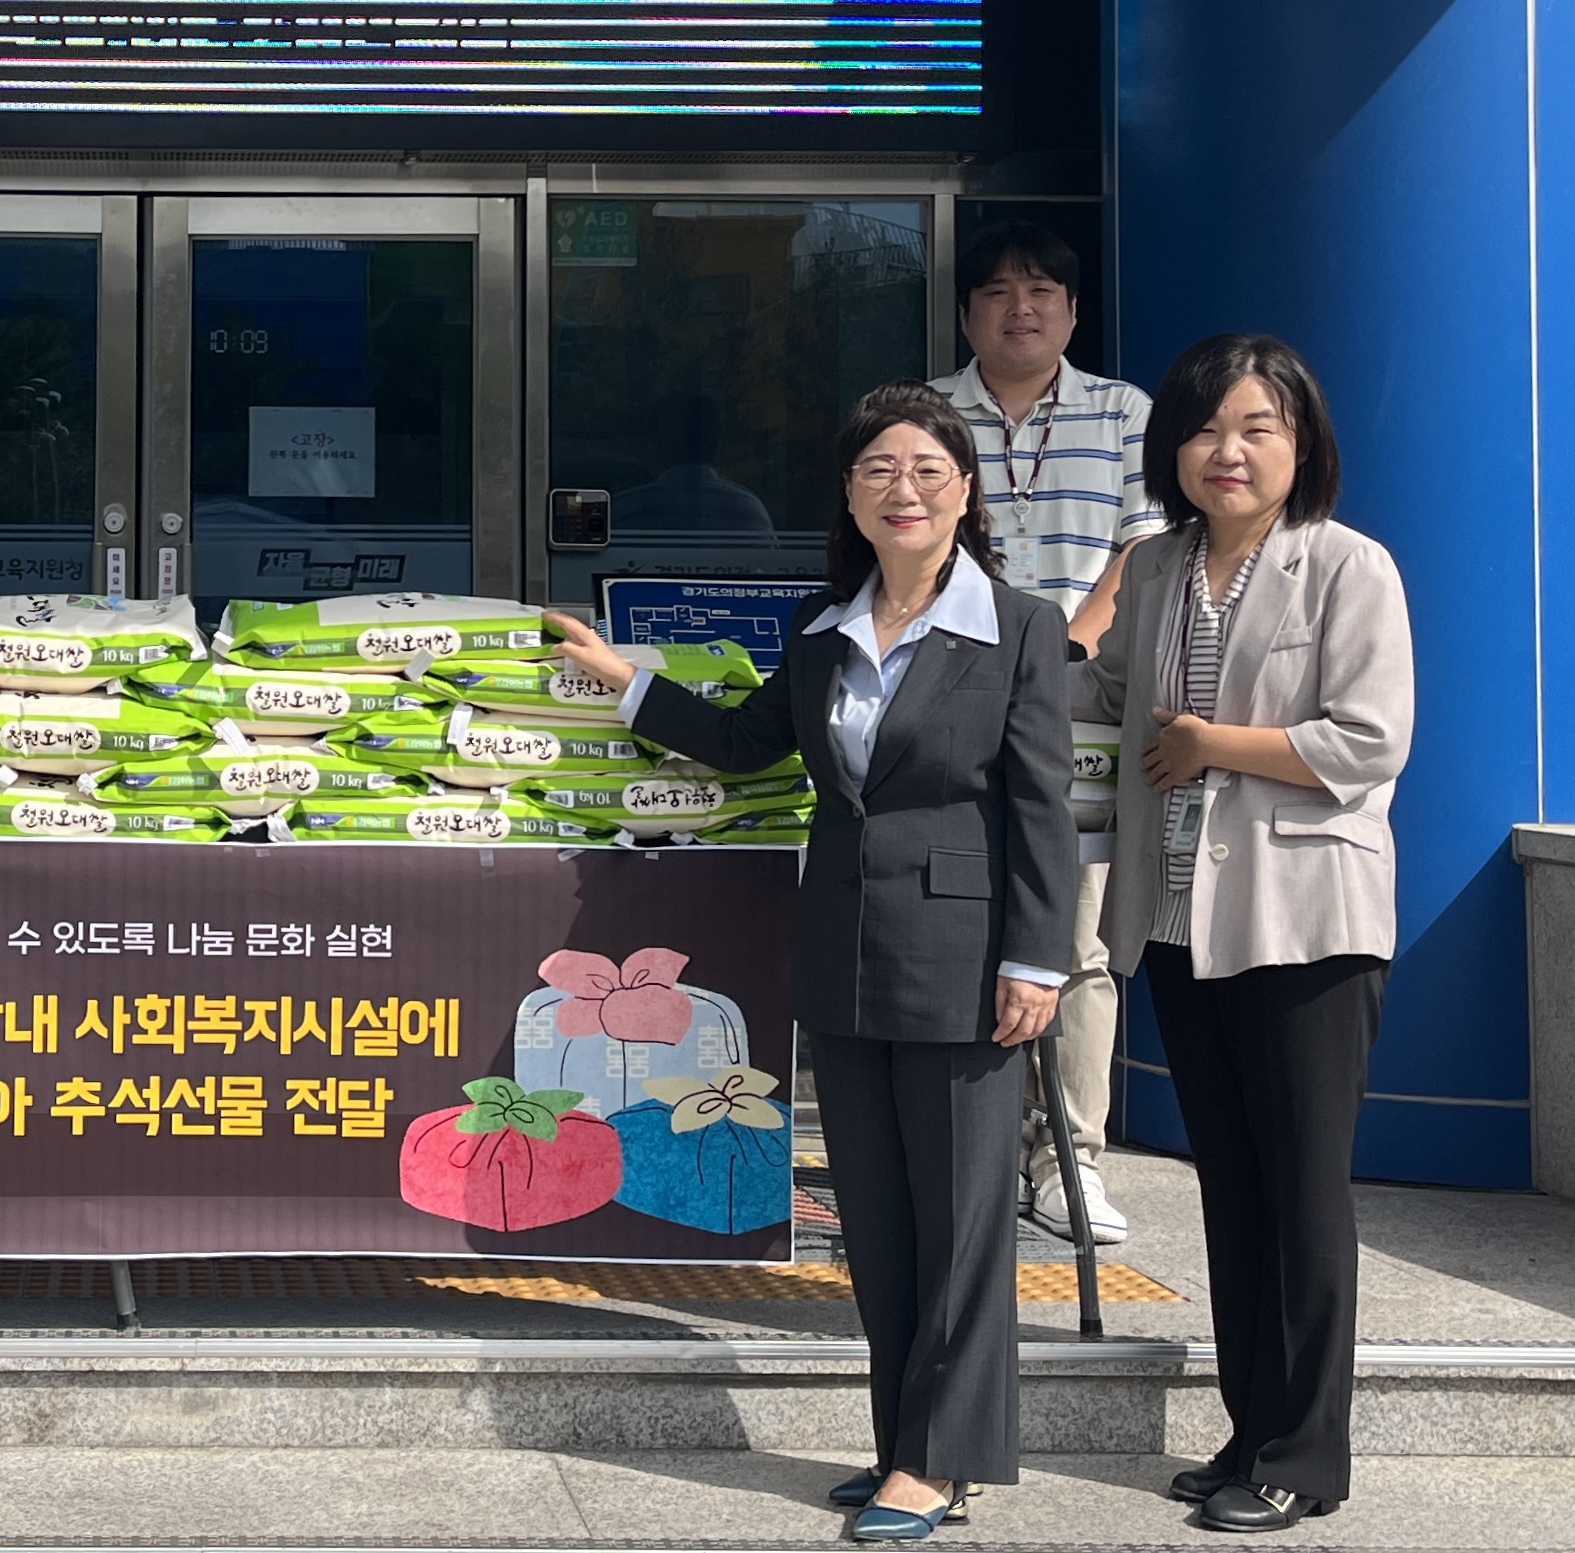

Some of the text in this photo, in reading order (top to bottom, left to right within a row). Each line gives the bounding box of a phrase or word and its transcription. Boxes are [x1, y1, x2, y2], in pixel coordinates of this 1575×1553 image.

[584, 211, 628, 226] AED
[210, 329, 268, 354] 10:09
[357, 558, 402, 579] 미래
[681, 586, 823, 599] 경기도의정부교육지원
[0, 639, 82, 668] 철원오대쌀
[103, 650, 116, 661] 10
[120, 650, 133, 662] kg
[366, 634, 503, 655] 철원오대쌀 10 kg
[558, 674, 617, 698] 철원오
[256, 685, 341, 714] 철원오대쌀
[362, 698, 375, 709] 10
[8, 729, 145, 750] 철원오대쌀 10 kg
[466, 734, 602, 760] 철원오대쌀 10 kg
[332, 774, 345, 786] 10
[349, 775, 362, 786] kg
[579, 785, 716, 808] 철원오대쌀 10 kg
[21, 804, 106, 832] 철원오대쌀
[128, 817, 141, 827] 10
[145, 816, 157, 828] kg
[415, 812, 501, 837] 철원오대쌀
[523, 821, 536, 832] 10
[540, 820, 553, 833] kg
[8, 922, 40, 954] 수
[54, 922, 155, 955] 있도록
[169, 923, 234, 955] 나눔
[246, 924, 315, 956] 문화
[326, 924, 391, 957] 실현
[76, 994, 459, 1056] 사회복지시설에
[51, 1076, 267, 1136] 추석선물
[286, 1078, 393, 1137] 전달
